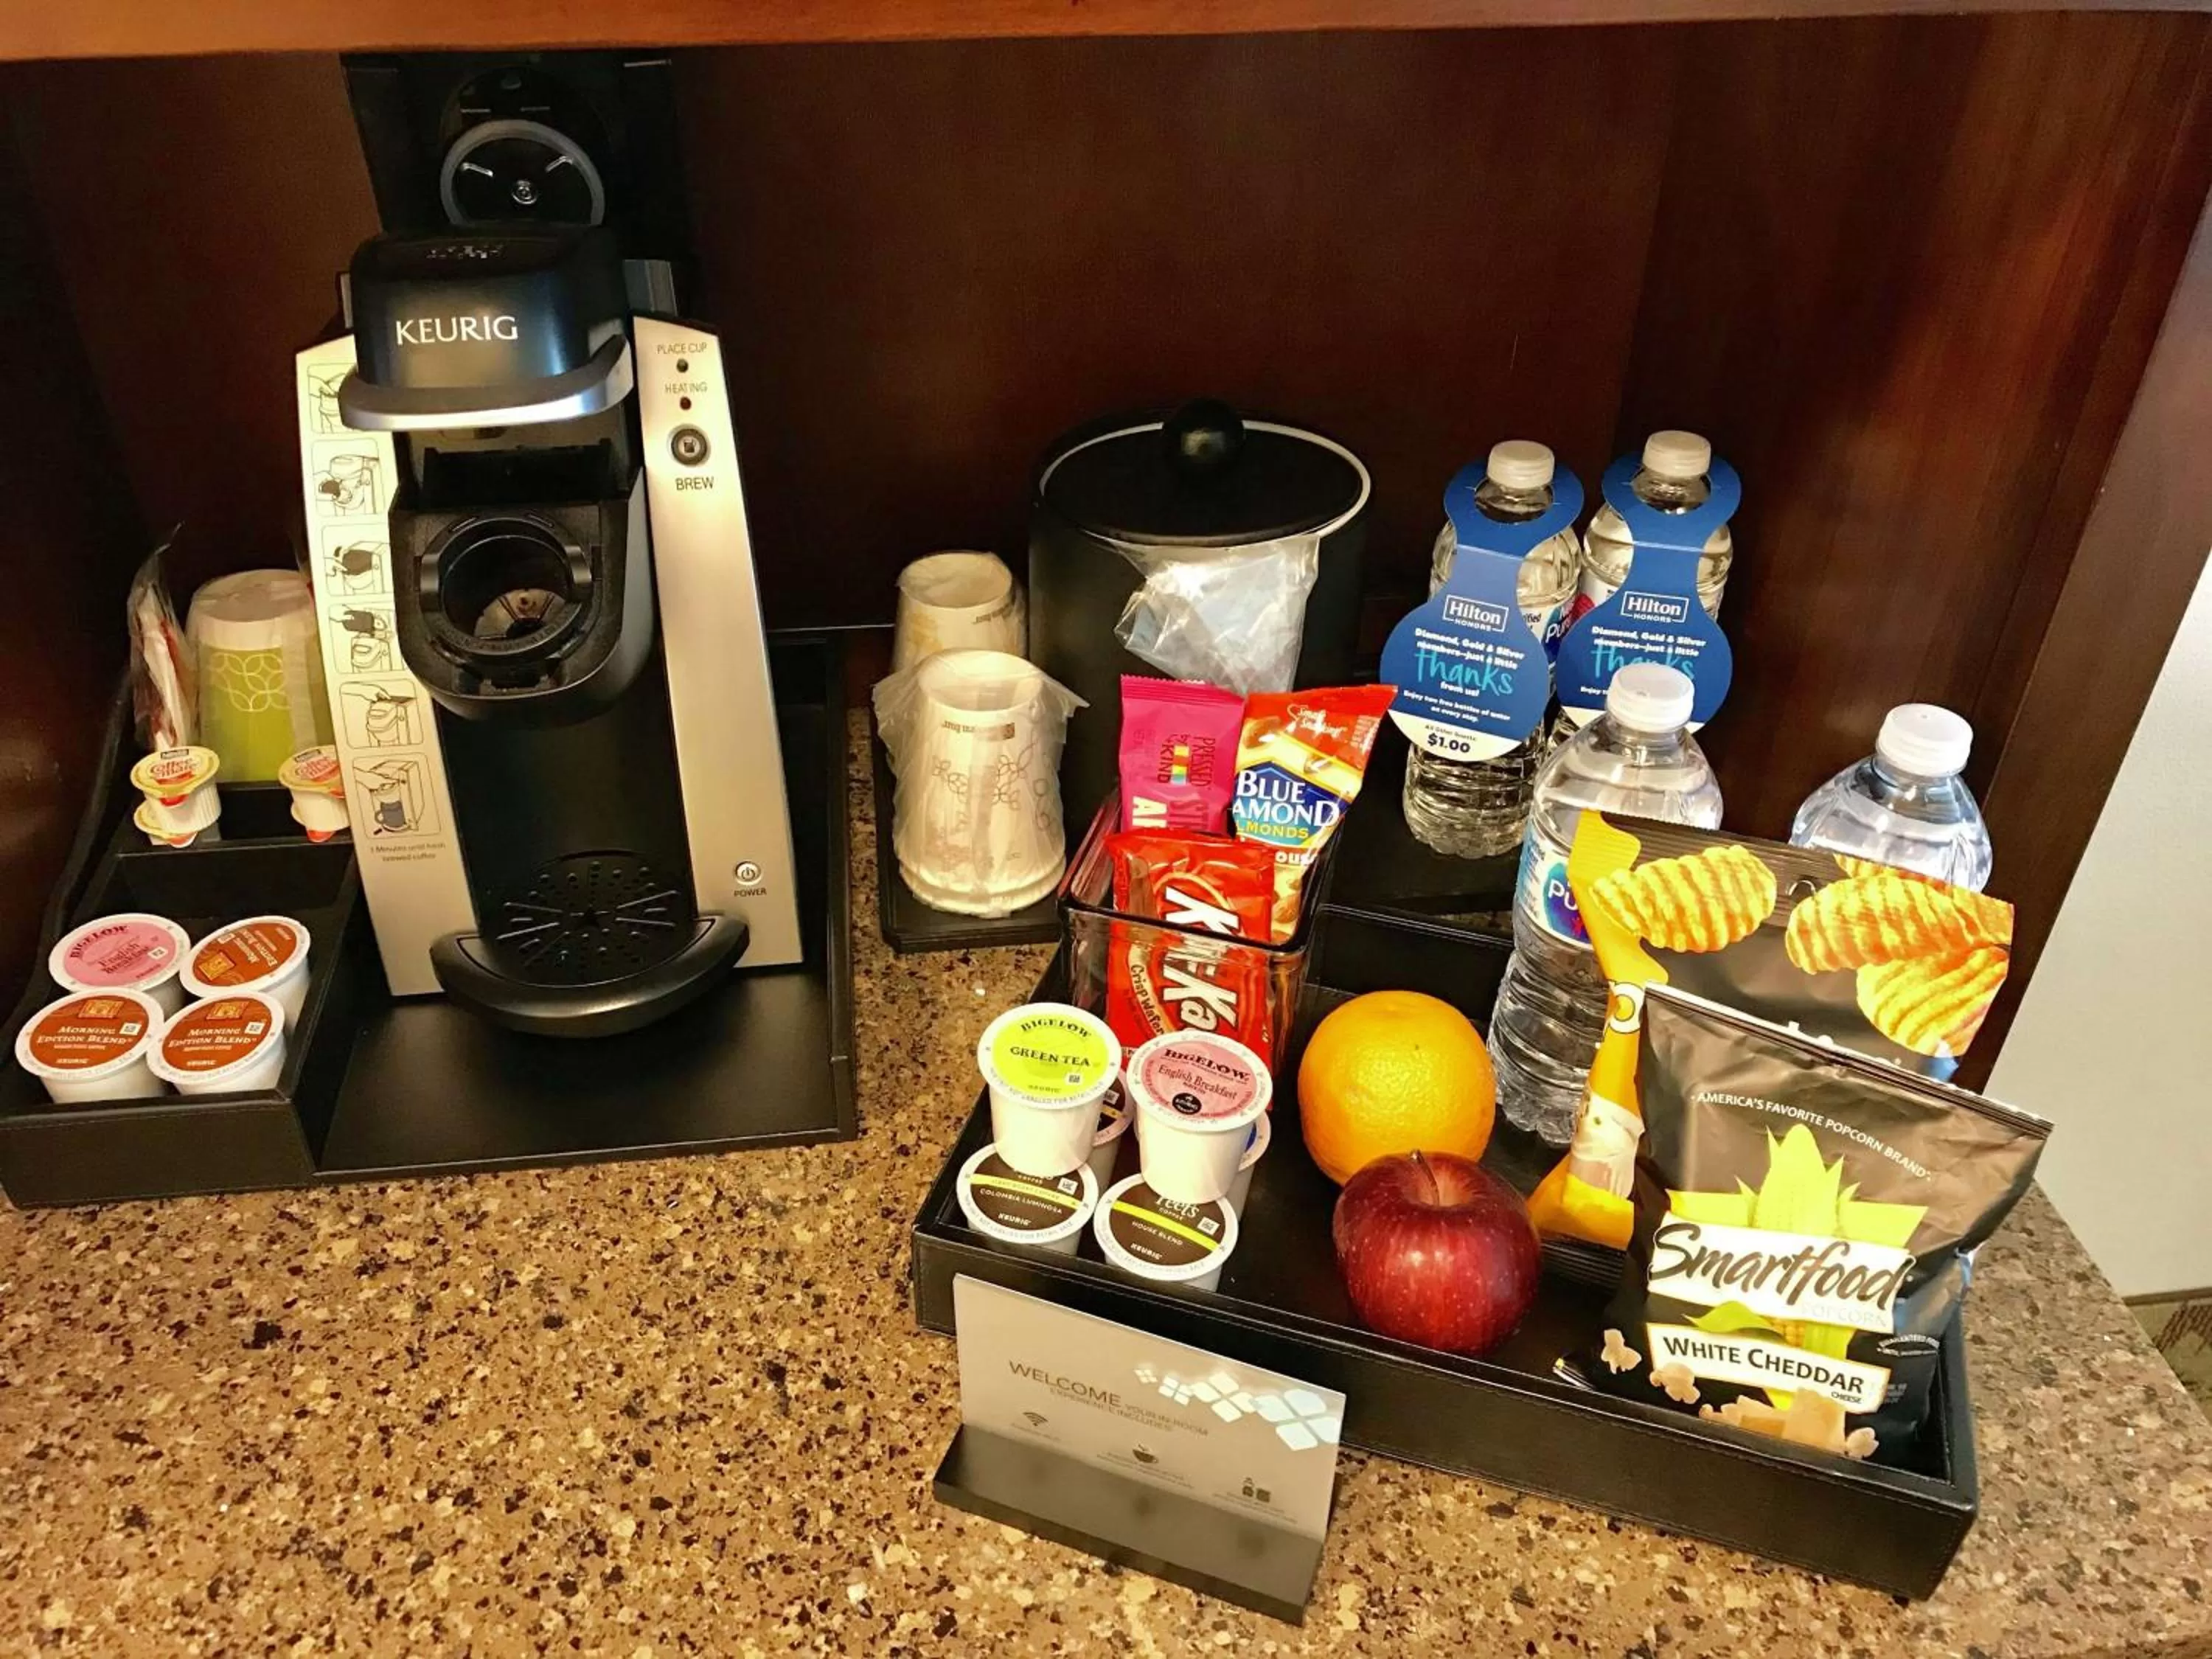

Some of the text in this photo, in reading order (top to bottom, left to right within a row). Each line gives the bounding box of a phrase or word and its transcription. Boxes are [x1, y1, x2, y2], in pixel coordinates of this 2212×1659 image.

[395, 316, 518, 345] KEURIG
[657, 341, 707, 355] PLACE CUP
[665, 382, 708, 394] HEATING
[675, 476, 714, 491] BREW
[1450, 601, 1501, 625] Hilton
[1628, 597, 1682, 616] Hilton
[1455, 618, 1492, 632] HONORS
[1634, 613, 1672, 623] HONORS
[1414, 627, 1526, 660] Diamond, Gold & Silver
[1592, 625, 1708, 647] Diamond, Gold & Silver
[1590, 643, 1695, 679] thks
[1674, 647, 1700, 657] little
[1494, 657, 1518, 670] little
[1440, 681, 1464, 694] from
[1580, 685, 1601, 695] Enjoy
[1403, 689, 1424, 701] Enjoy
[1439, 698, 1453, 708] free
[1454, 701, 1481, 714] bottles
[1490, 712, 1511, 721] water
[1427, 732, 1471, 754] $1.00
[1158, 744, 1175, 783] KIND
[1190, 737, 1217, 787] PRESSED
[1237, 770, 1306, 804] BLUE
[1232, 798, 1340, 827] AMOND
[1236, 820, 1310, 838] LMONDS
[734, 888, 767, 897] POWER
[70, 925, 128, 959] BIGELOW
[1130, 963, 1149, 995] Crisp
[1141, 995, 1166, 1035] Wafer
[1163, 964, 1239, 1031] Ka
[1020, 1018, 1091, 1038] BIGELOW
[1009, 1046, 1091, 1068] GREEN TEA
[1164, 1048, 1251, 1082] BIGELOW
[1158, 1063, 1193, 1083] English
[1194, 1075, 1238, 1101] Breakfast
[1697, 1091, 1764, 1110] AMERICA'S
[1765, 1100, 1824, 1126] FAVORITE
[1824, 1118, 1884, 1152] POPCORN
[979, 1187, 1021, 1203] COLOMBIA
[998, 1213, 1032, 1226] KEURIG
[1131, 1221, 1183, 1245] HOUSE BLEND
[1130, 1242, 1163, 1260] KEURIG
[1648, 1222, 1916, 1311] Smartfood
[1663, 1336, 1742, 1365] WHITE
[1747, 1348, 1865, 1394] CHEDDAR
[1009, 1360, 1121, 1408] WELCOME
[1831, 1391, 1863, 1405] CHEESE
